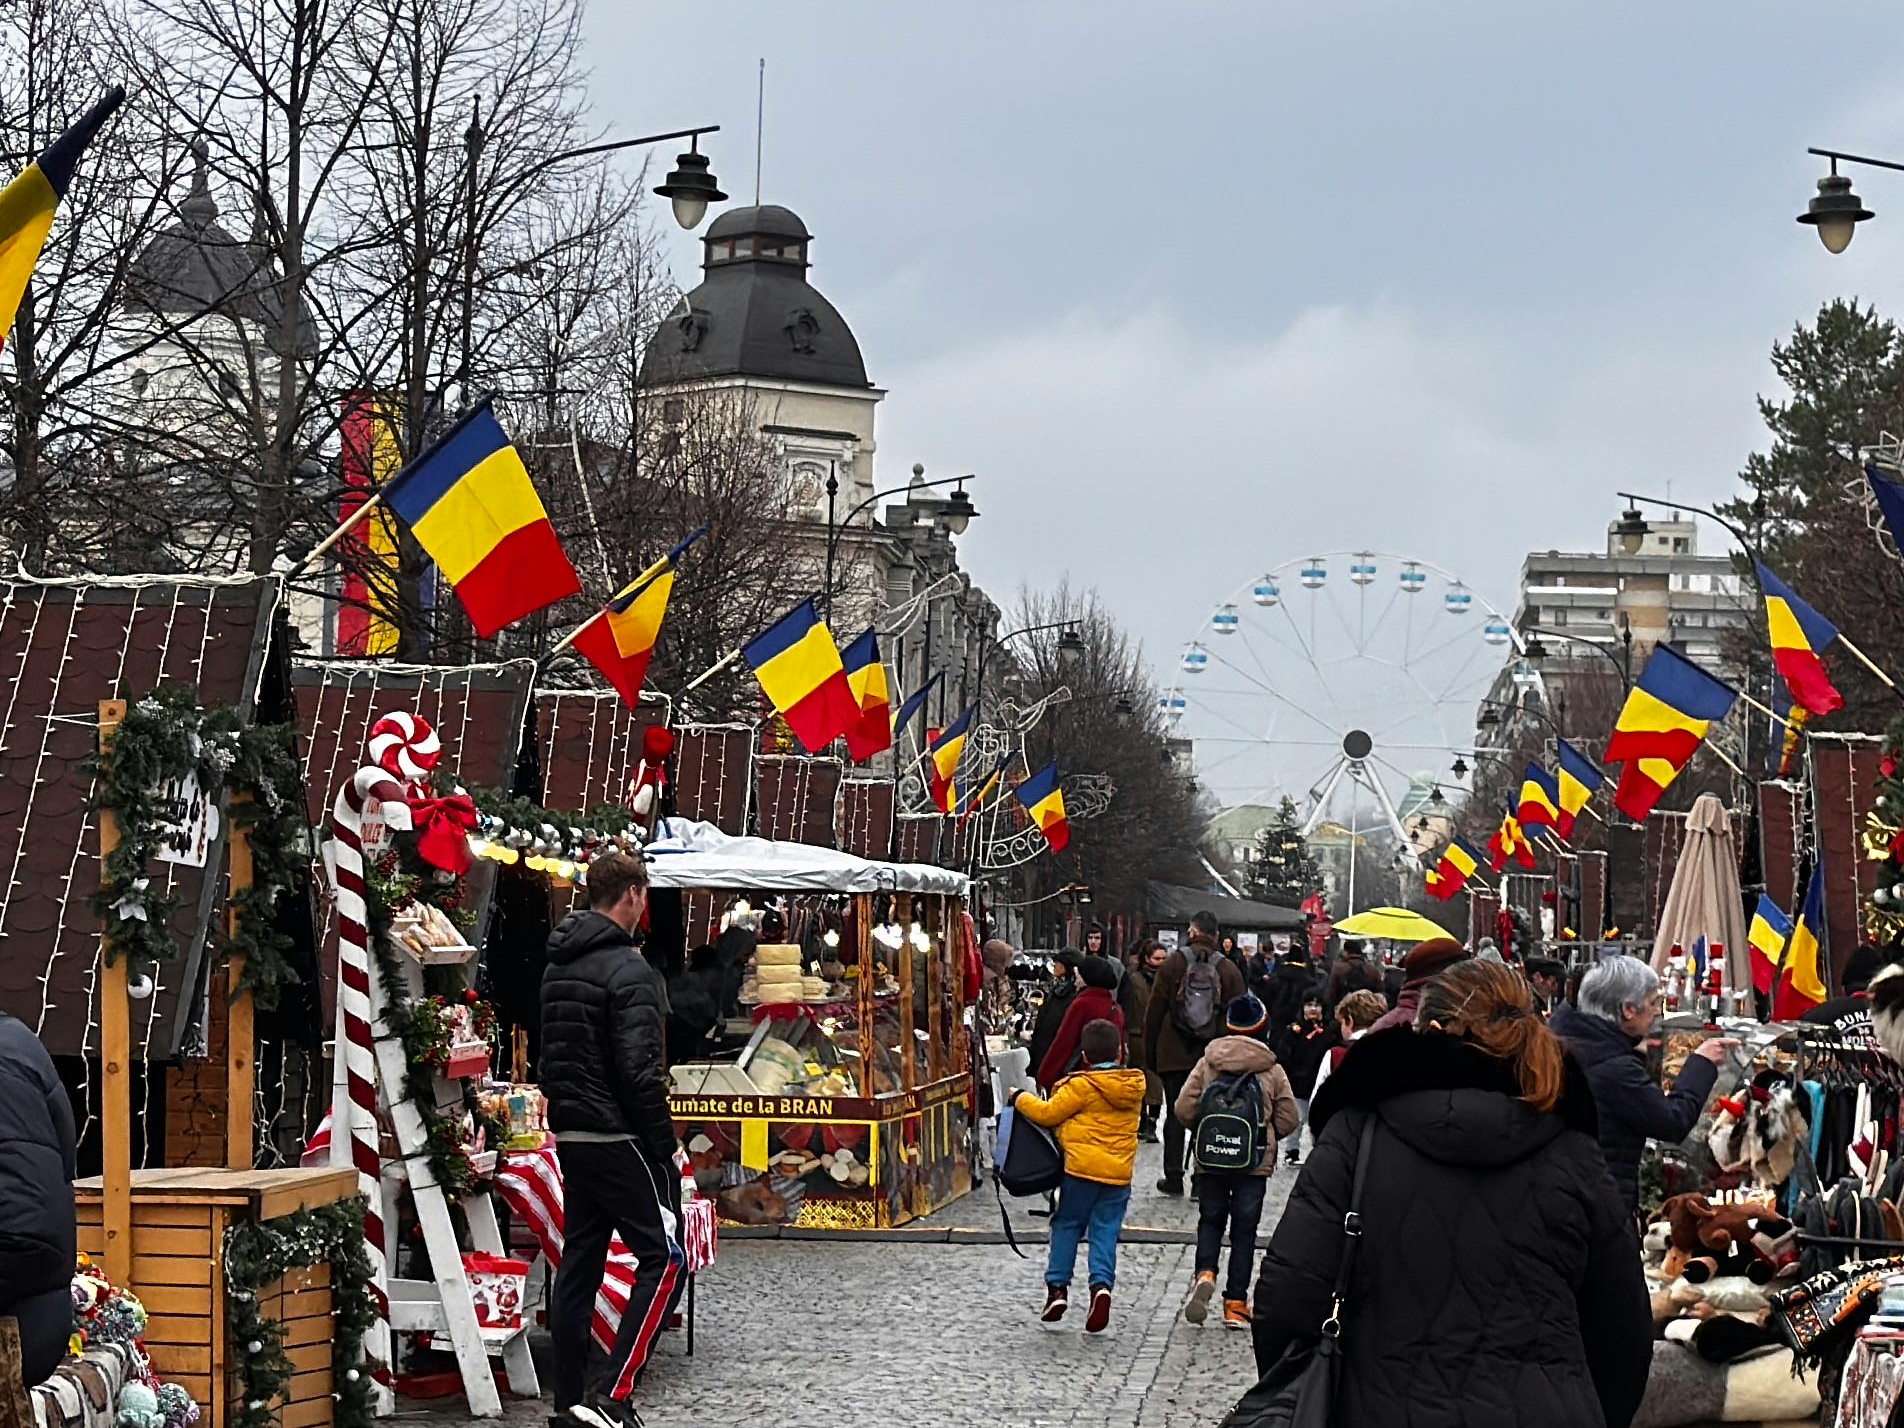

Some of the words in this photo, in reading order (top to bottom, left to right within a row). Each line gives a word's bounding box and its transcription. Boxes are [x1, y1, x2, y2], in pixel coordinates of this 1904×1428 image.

[731, 1097, 753, 1113] de
[758, 1097, 774, 1114] la
[780, 1098, 833, 1115] BRAN
[1215, 1134, 1241, 1145] Pixel
[1205, 1144, 1240, 1156] Power
